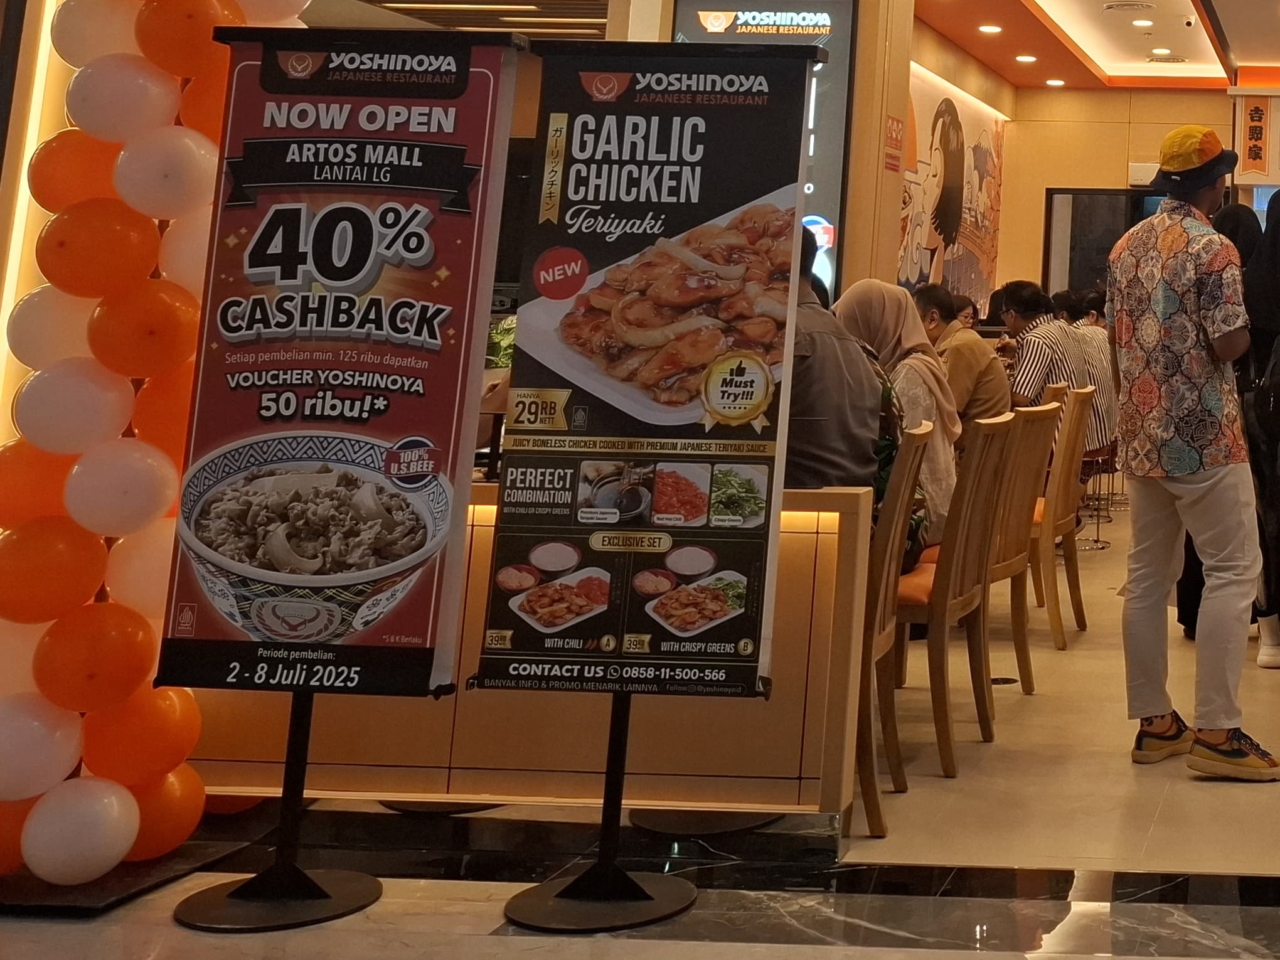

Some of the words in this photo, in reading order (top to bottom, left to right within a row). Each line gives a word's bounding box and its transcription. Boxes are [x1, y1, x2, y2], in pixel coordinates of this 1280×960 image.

[736, 11, 831, 26] YOSHINOYA
[736, 24, 778, 34] JAPANESE
[779, 25, 831, 35] RESTAURANT
[329, 52, 456, 72] YOSHINOYA
[327, 71, 382, 82] JAPANESE
[386, 72, 456, 84] RESTAURANT
[635, 73, 769, 92] YOSHINOYA
[633, 93, 695, 104] JAPANESE
[698, 94, 769, 106] RESTAURANT
[263, 102, 351, 130] NOW
[358, 103, 456, 133] OPEN
[571, 114, 706, 162] GARLIC
[286, 144, 357, 164] ARTOS
[364, 144, 423, 167] MALL
[314, 165, 367, 181] LANTAI
[372, 167, 391, 182] LG
[545, 127, 564, 211] ガーリックチキン
[567, 163, 702, 203] CHICKEN
[564, 205, 665, 241] Teriyaki
[245, 202, 433, 287] 40%
[539, 260, 582, 284] NEW
[219, 293, 451, 344] CASHBACK
[225, 352, 256, 364] Setiap
[258, 350, 310, 363] pembelian
[313, 351, 335, 361] min.
[338, 350, 357, 361] 125
[360, 352, 380, 364] ribu
[383, 353, 429, 369] dapatkan
[227, 370, 313, 388] VOUCHER
[317, 370, 424, 393] YOSHINOYA
[720, 378, 755, 388] Must
[720, 390, 754, 402] Try!!!
[260, 392, 297, 416] 50
[513, 400, 540, 425] 29
[540, 401, 557, 415] RB
[539, 417, 555, 425] NETT
[512, 439, 530, 448] JUICY
[532, 439, 566, 448] BONELESS
[568, 439, 597, 449] CHICKEN
[599, 440, 626, 449] COOKED
[627, 440, 645, 450] WITH
[646, 441, 678, 451] PREMIUM
[679, 442, 713, 452] JAPANESE
[714, 443, 744, 452] TERIYAKI
[745, 444, 768, 453] SAUCE
[399, 449, 429, 463] 100%
[390, 461, 435, 474] U.S.BEEF
[506, 468, 574, 488] PERFECT
[504, 489, 572, 504] COMBINATION
[601, 536, 646, 547] EXCLUSIVE
[647, 537, 662, 548] SET
[488, 635, 499, 646] 39
[544, 638, 563, 648] WITH
[564, 639, 583, 649] CHILI
[605, 638, 611, 648] A
[626, 639, 638, 650] 39
[661, 641, 679, 652] WITH
[680, 642, 706, 652] CRISPY
[707, 643, 735, 653] GREENS
[743, 642, 749, 652] B
[257, 647, 288, 658] Periode
[290, 648, 336, 661] pembelian:
[226, 662, 240, 682] 2
[254, 663, 268, 684] 8
[269, 663, 307, 685] Juli
[309, 665, 361, 687] 2025
[509, 663, 581, 676] CONTACT
[584, 666, 604, 677] US
[622, 666, 726, 680] 0858-11-500-566
[484, 679, 516, 687] BANYAK
[519, 680, 539, 688] INFO
[549, 681, 581, 689] PROMO
[583, 682, 621, 690] MENARIK
[623, 683, 658, 692] LAINNYA
